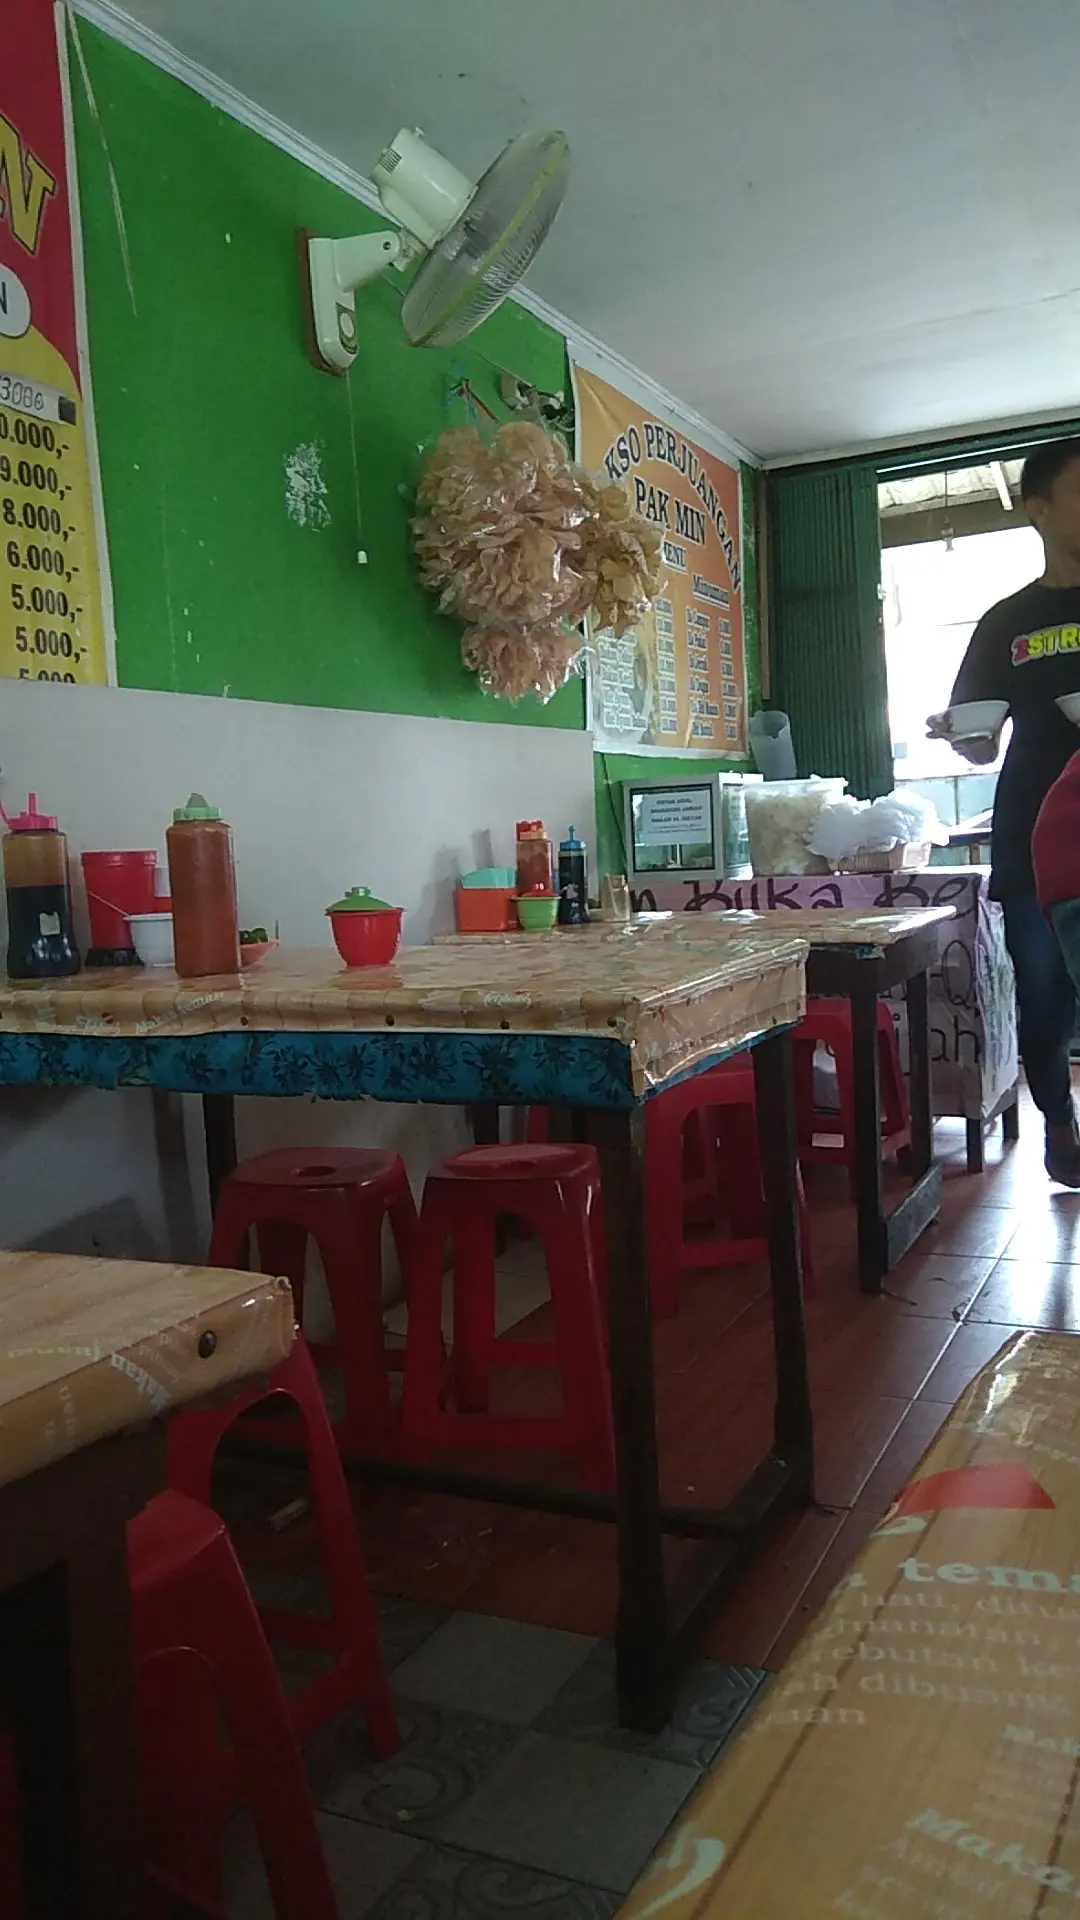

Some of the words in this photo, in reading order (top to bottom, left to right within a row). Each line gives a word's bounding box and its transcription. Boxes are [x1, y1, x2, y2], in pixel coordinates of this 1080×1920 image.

[0, 455, 72, 500] 9.000,-
[634, 477, 671, 530] PAK
[675, 500, 706, 545] MIN
[643, 423, 741, 590] PERJUANGAN
[7, 541, 79, 583] 6.000,-
[11, 584, 83, 623] 5.000,-
[15, 626, 87, 664] 5.000,-
[897, 1557, 1080, 1594] tem
